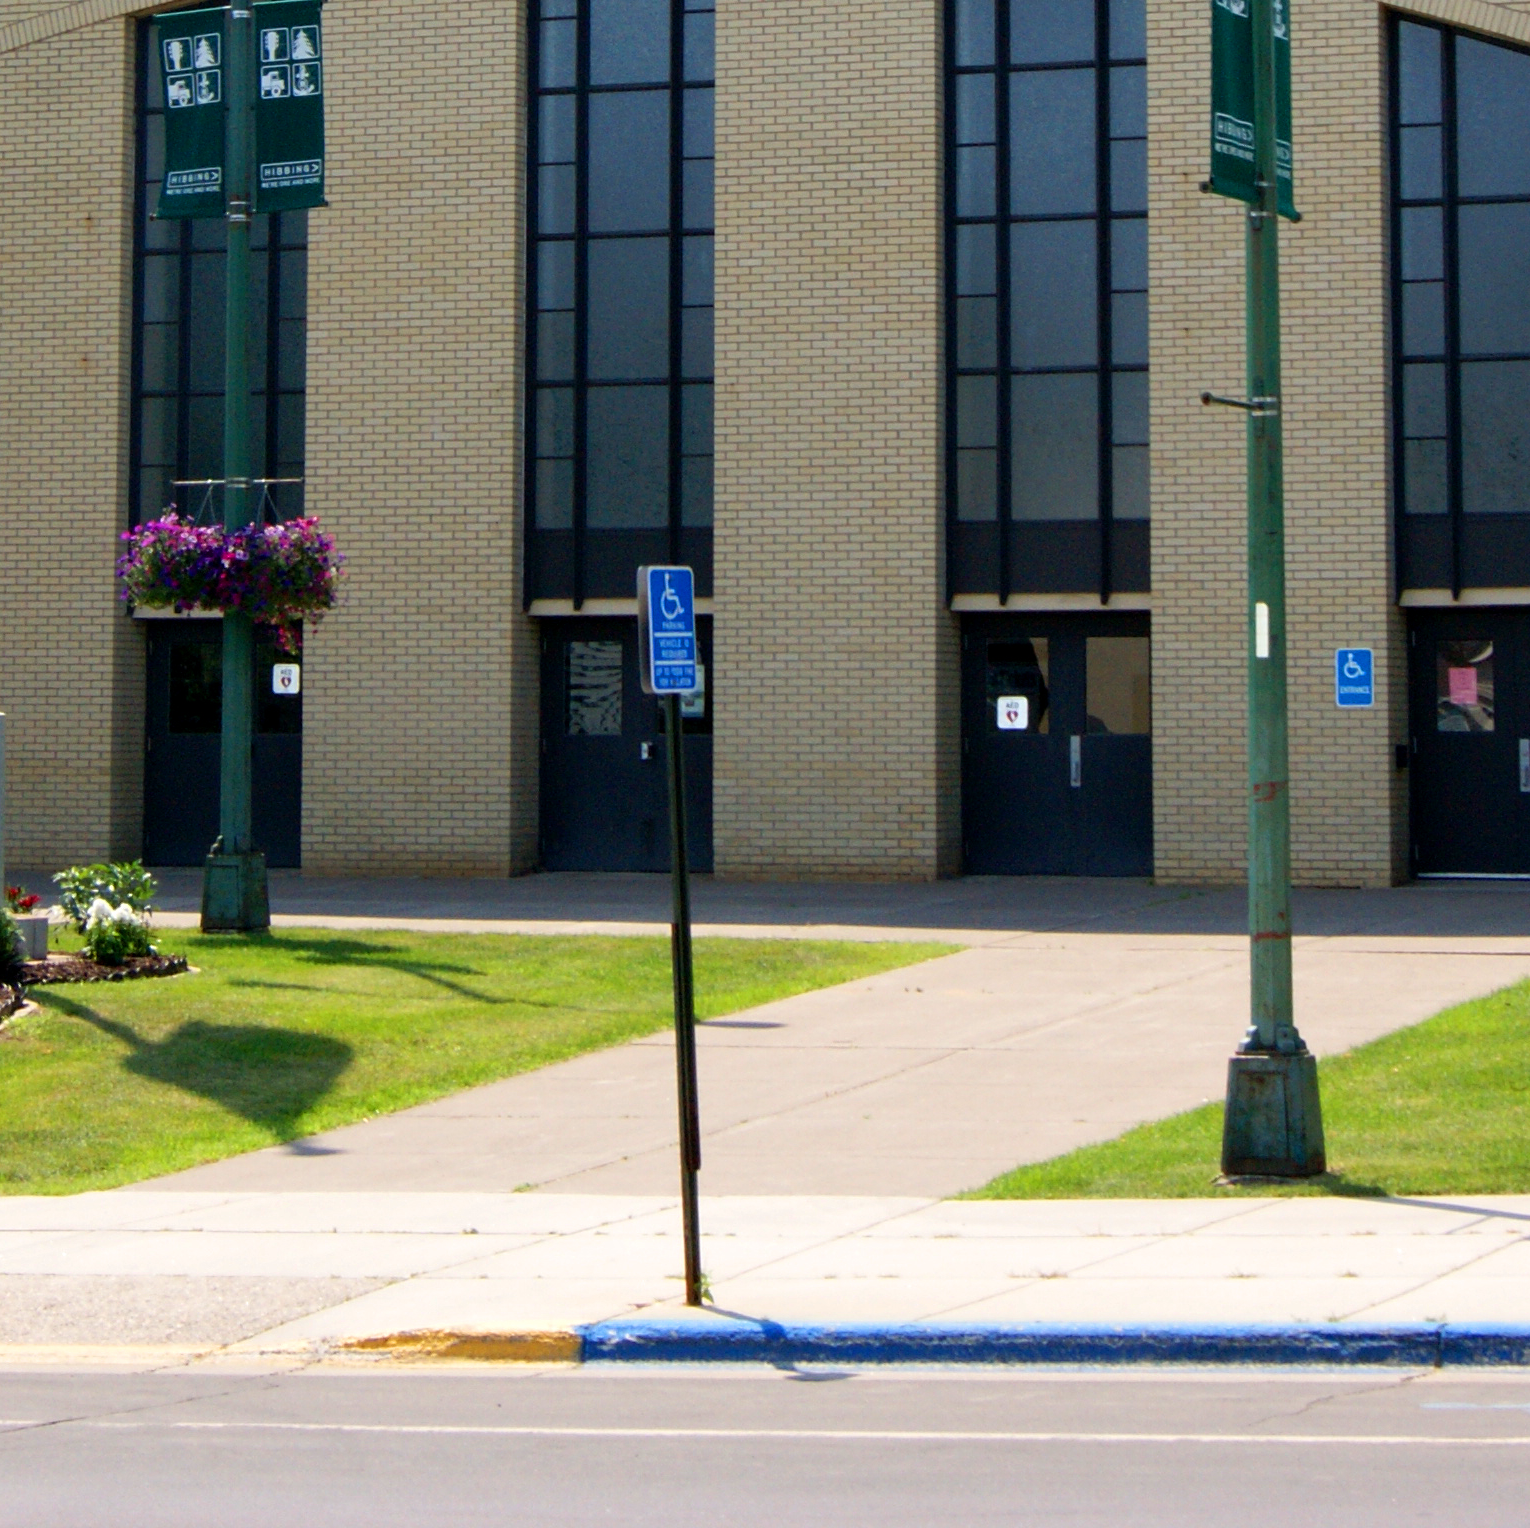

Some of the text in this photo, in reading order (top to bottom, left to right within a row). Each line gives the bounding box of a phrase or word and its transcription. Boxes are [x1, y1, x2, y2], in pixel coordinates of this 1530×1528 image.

[264, 164, 310, 177] HIBBING
[171, 172, 210, 184] HIBBING
[1340, 685, 1369, 694] ENTRANCE
